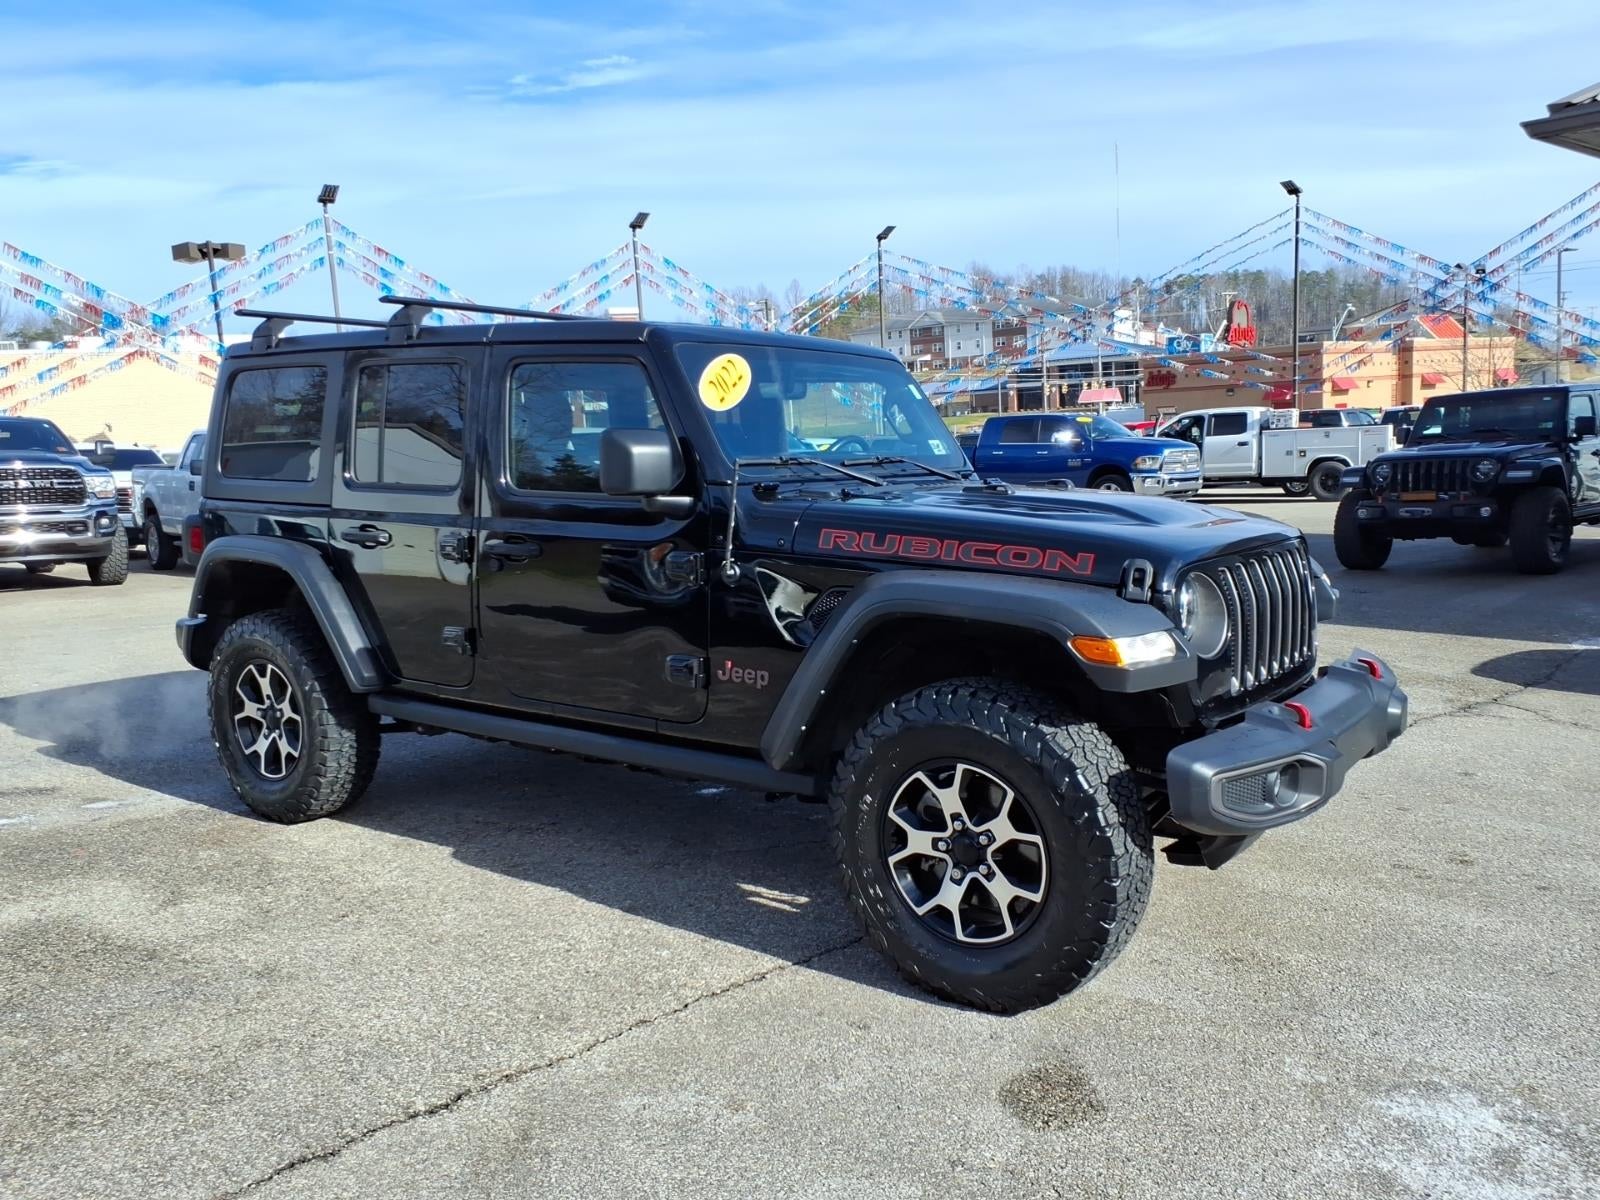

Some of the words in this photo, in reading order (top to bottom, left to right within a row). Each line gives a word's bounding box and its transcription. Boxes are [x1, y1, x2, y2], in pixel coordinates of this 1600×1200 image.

[708, 360, 743, 403] 2022
[818, 528, 1096, 575] RUBICON
[717, 660, 769, 689] Jeep
